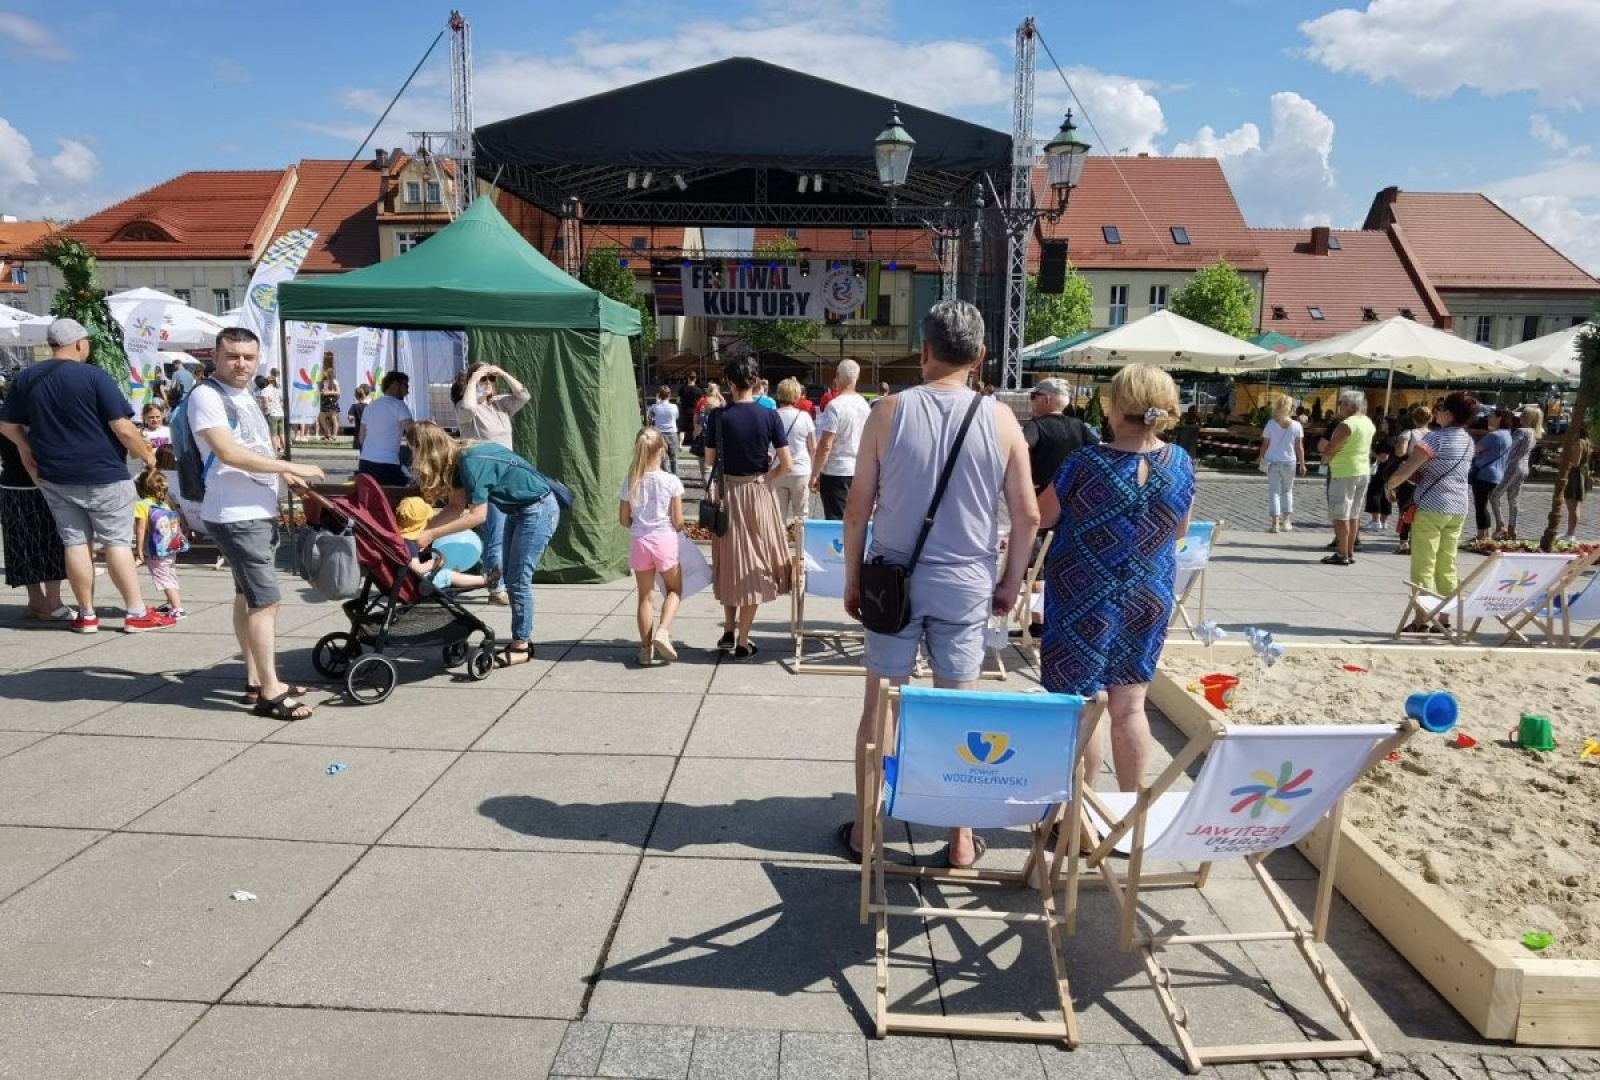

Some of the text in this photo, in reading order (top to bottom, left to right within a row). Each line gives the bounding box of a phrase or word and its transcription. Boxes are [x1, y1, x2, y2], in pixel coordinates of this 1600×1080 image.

[691, 264, 791, 290] FESTIWAL
[703, 291, 811, 316] KULTURY
[942, 772, 1028, 786] WODZISŁAWSKI
